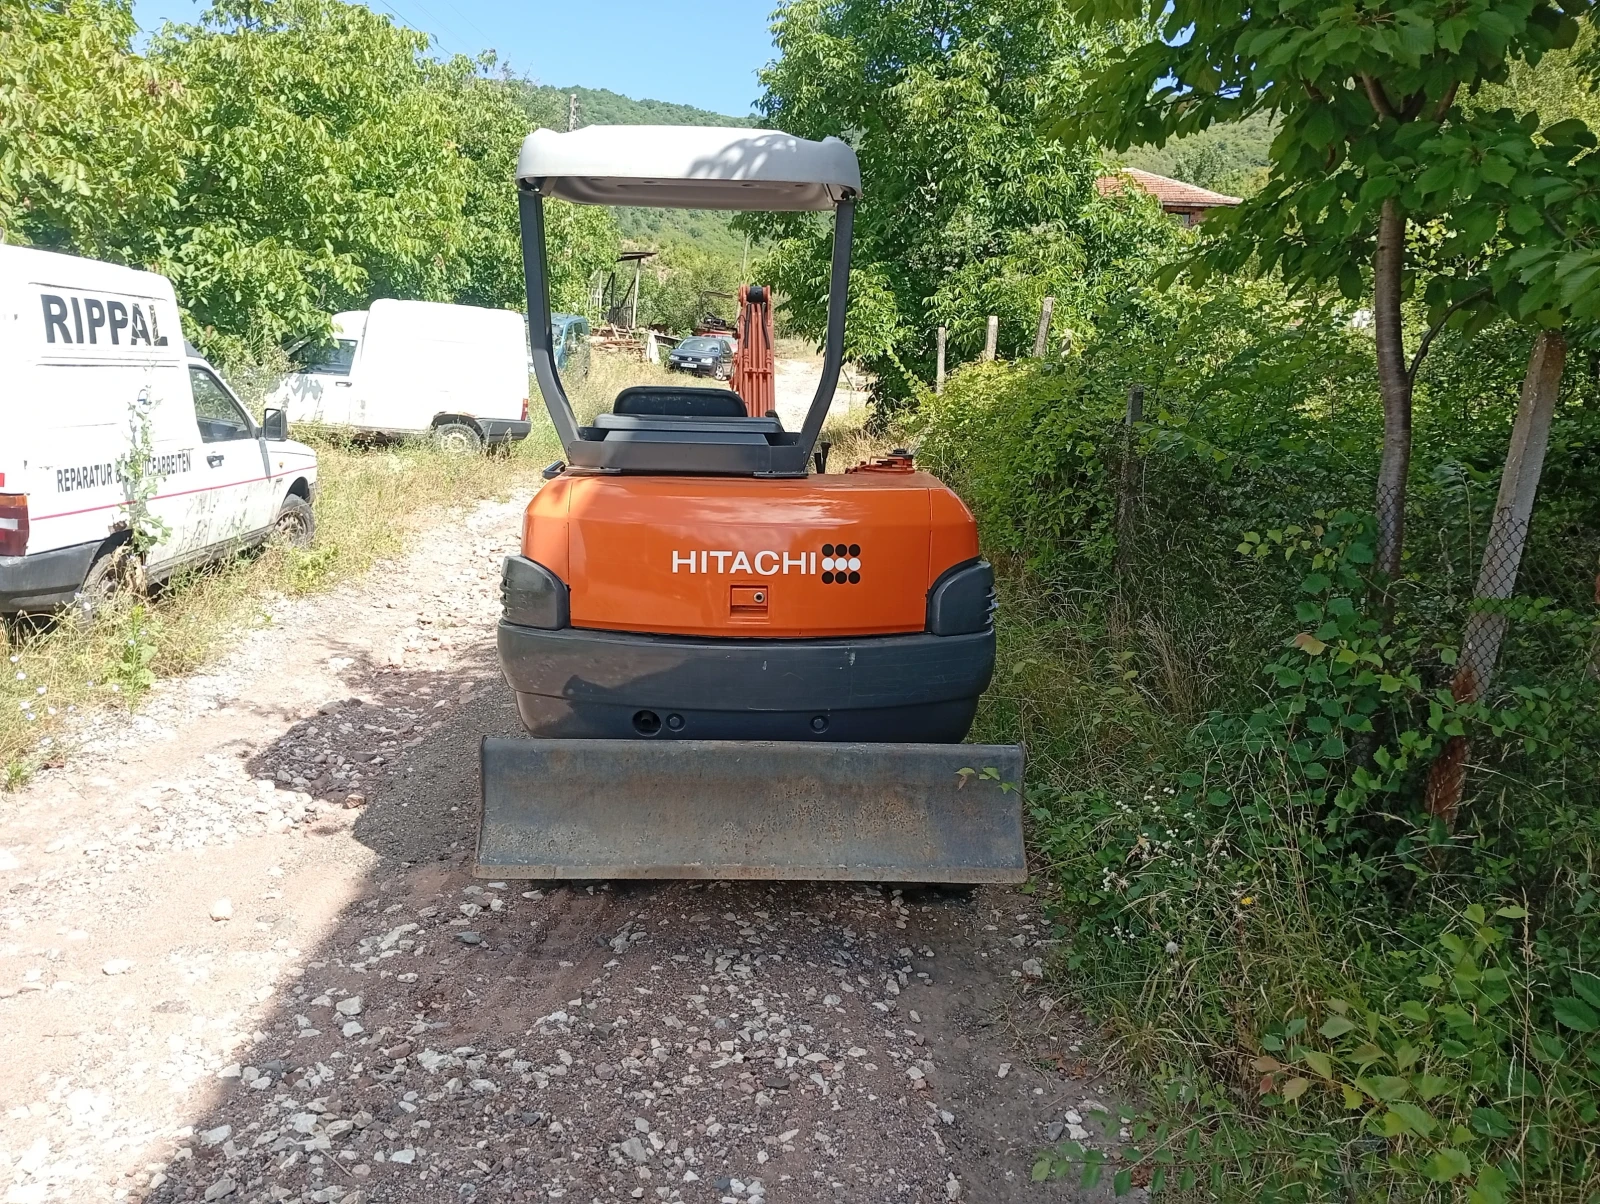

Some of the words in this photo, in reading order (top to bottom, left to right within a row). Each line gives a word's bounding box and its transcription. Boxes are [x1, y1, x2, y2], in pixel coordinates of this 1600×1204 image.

[40, 294, 168, 346] RIPPAL
[57, 463, 113, 493] REPARATUR
[672, 550, 817, 575] HITACHI
